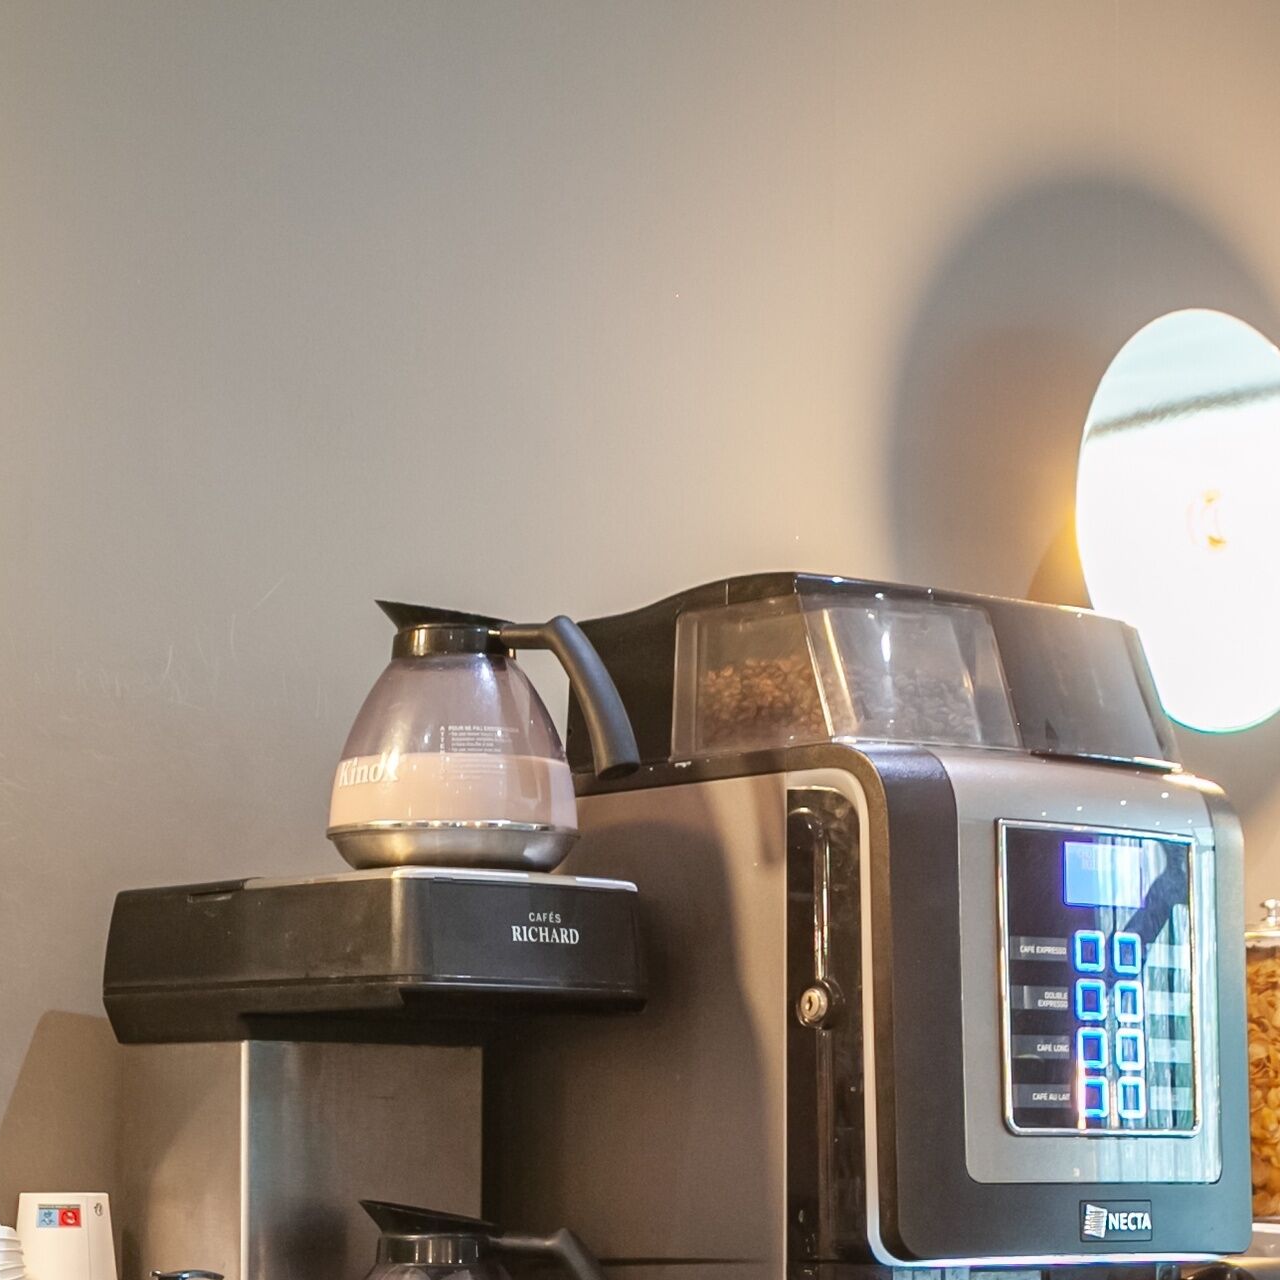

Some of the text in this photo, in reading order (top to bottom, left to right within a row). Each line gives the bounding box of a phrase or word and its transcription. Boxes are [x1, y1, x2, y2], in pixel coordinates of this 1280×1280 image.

[528, 911, 562, 923] CAFÉS
[511, 925, 580, 944] RICHARD
[1108, 1212, 1152, 1230] NECTA
